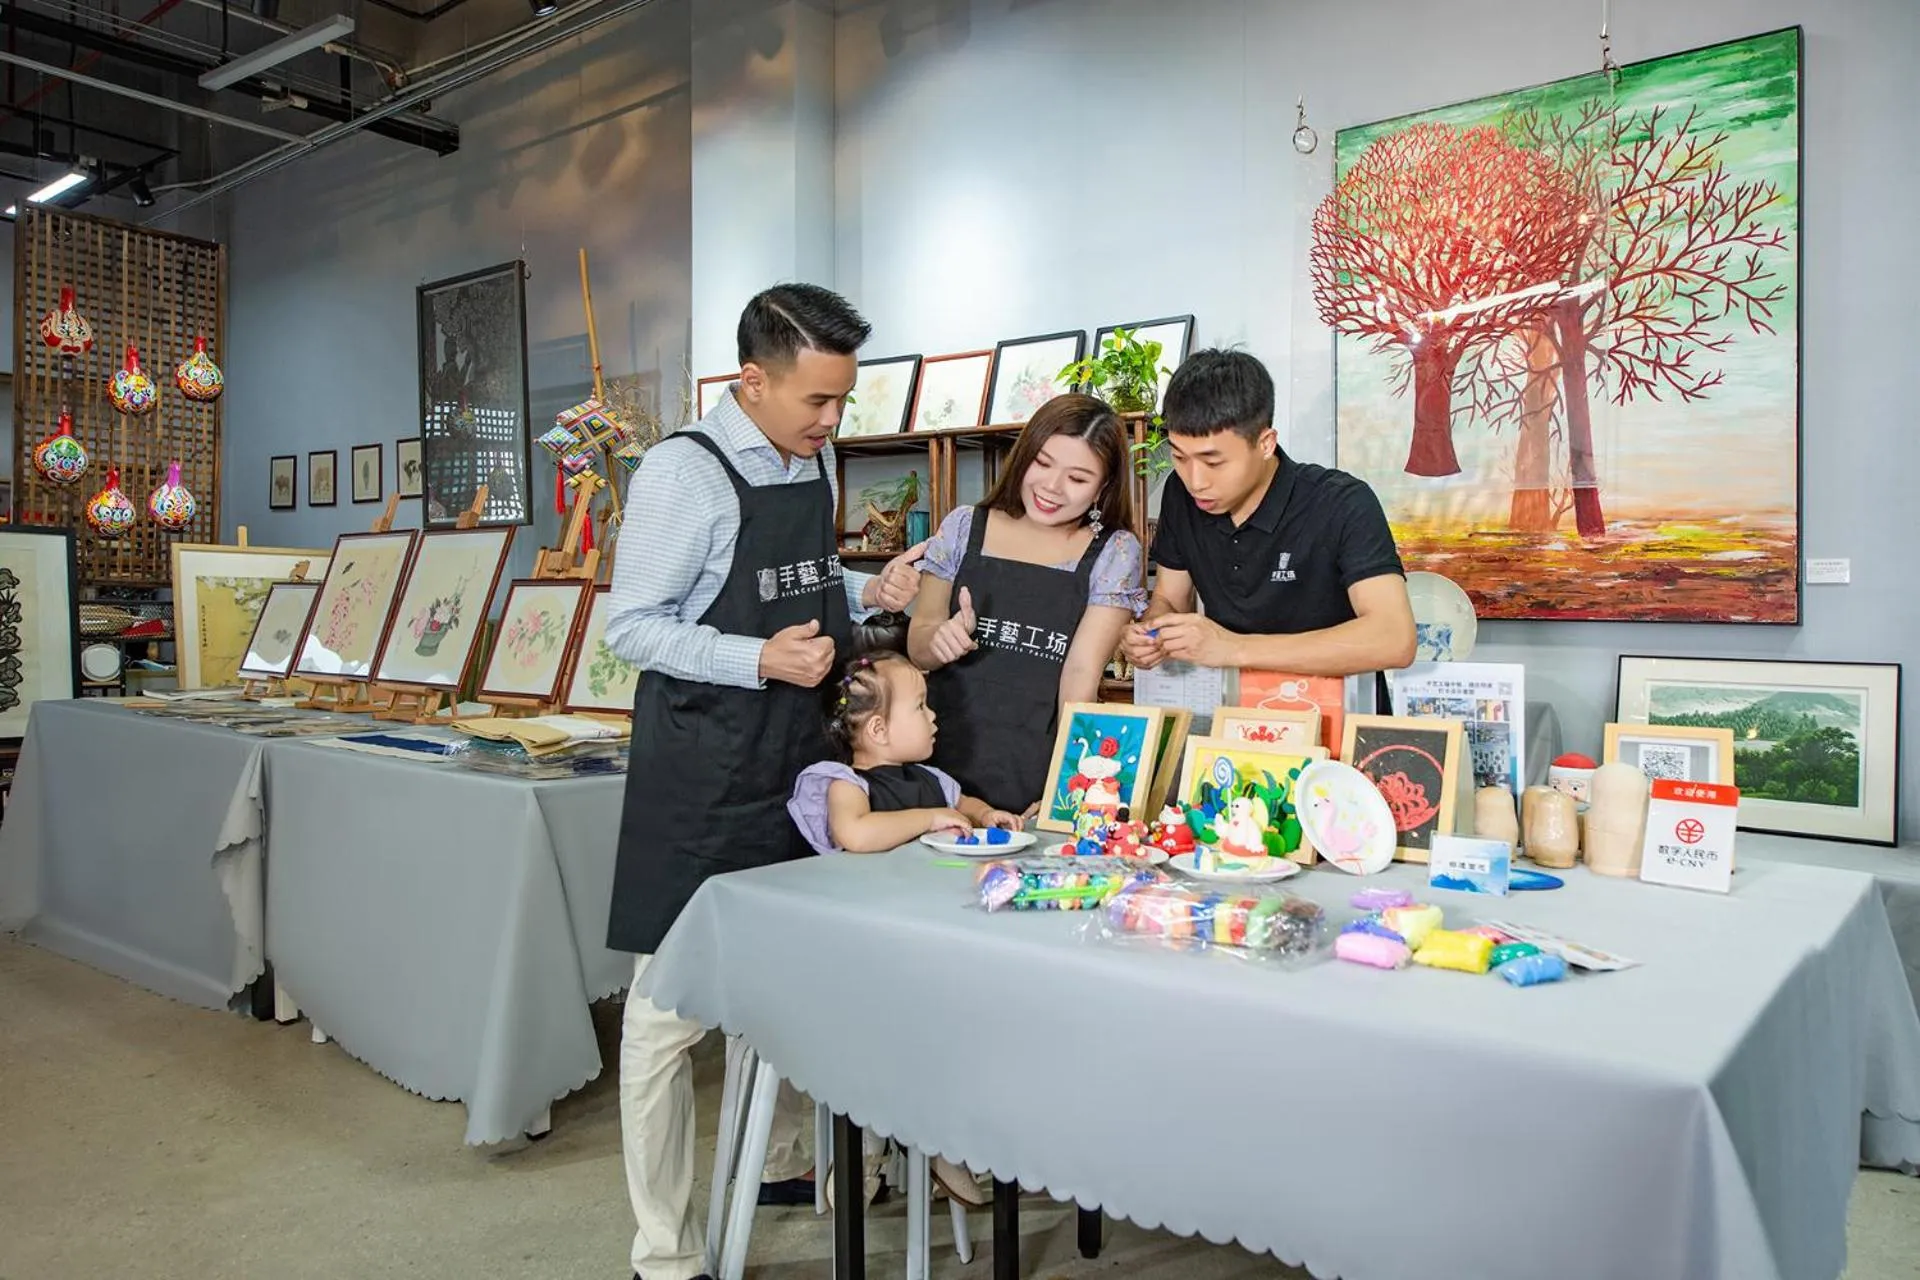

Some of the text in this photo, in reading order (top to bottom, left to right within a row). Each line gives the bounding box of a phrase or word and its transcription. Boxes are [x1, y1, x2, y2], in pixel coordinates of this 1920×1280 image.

[977, 616, 1068, 655] 手藝工场
[1658, 844, 1719, 861] 数字人民币
